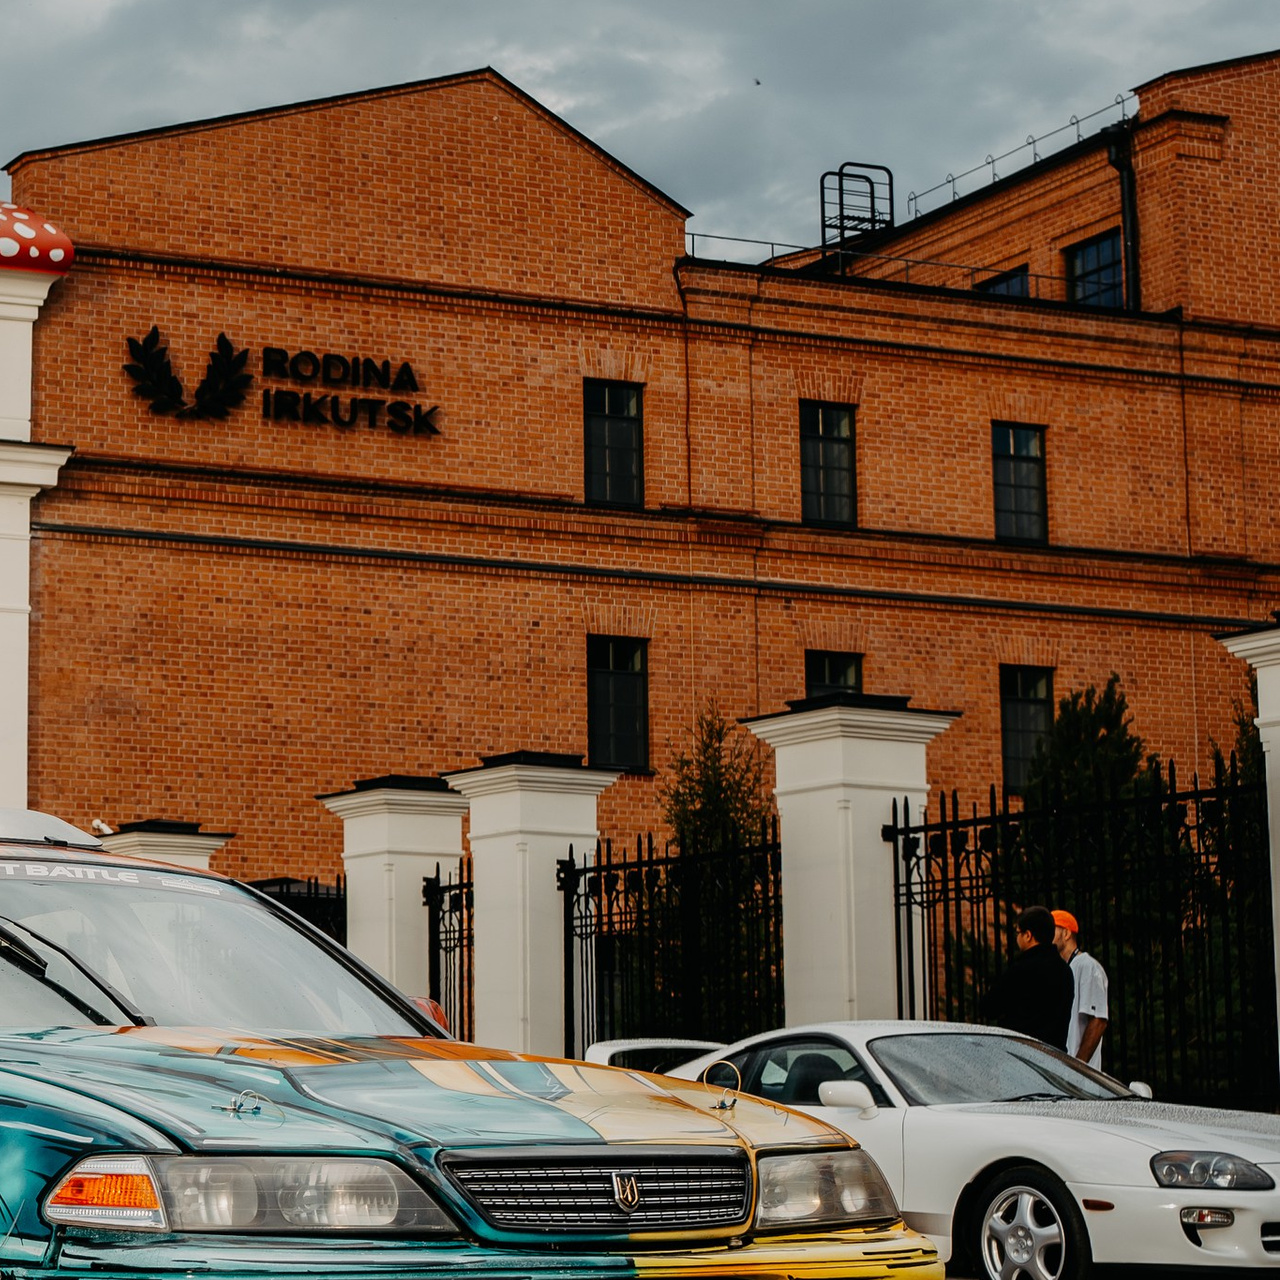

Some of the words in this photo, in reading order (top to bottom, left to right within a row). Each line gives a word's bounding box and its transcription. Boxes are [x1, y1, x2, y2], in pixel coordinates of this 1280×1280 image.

[262, 346, 420, 392] RODINA
[262, 388, 442, 435] IRKUTSK
[25, 864, 140, 884] BATTLE
